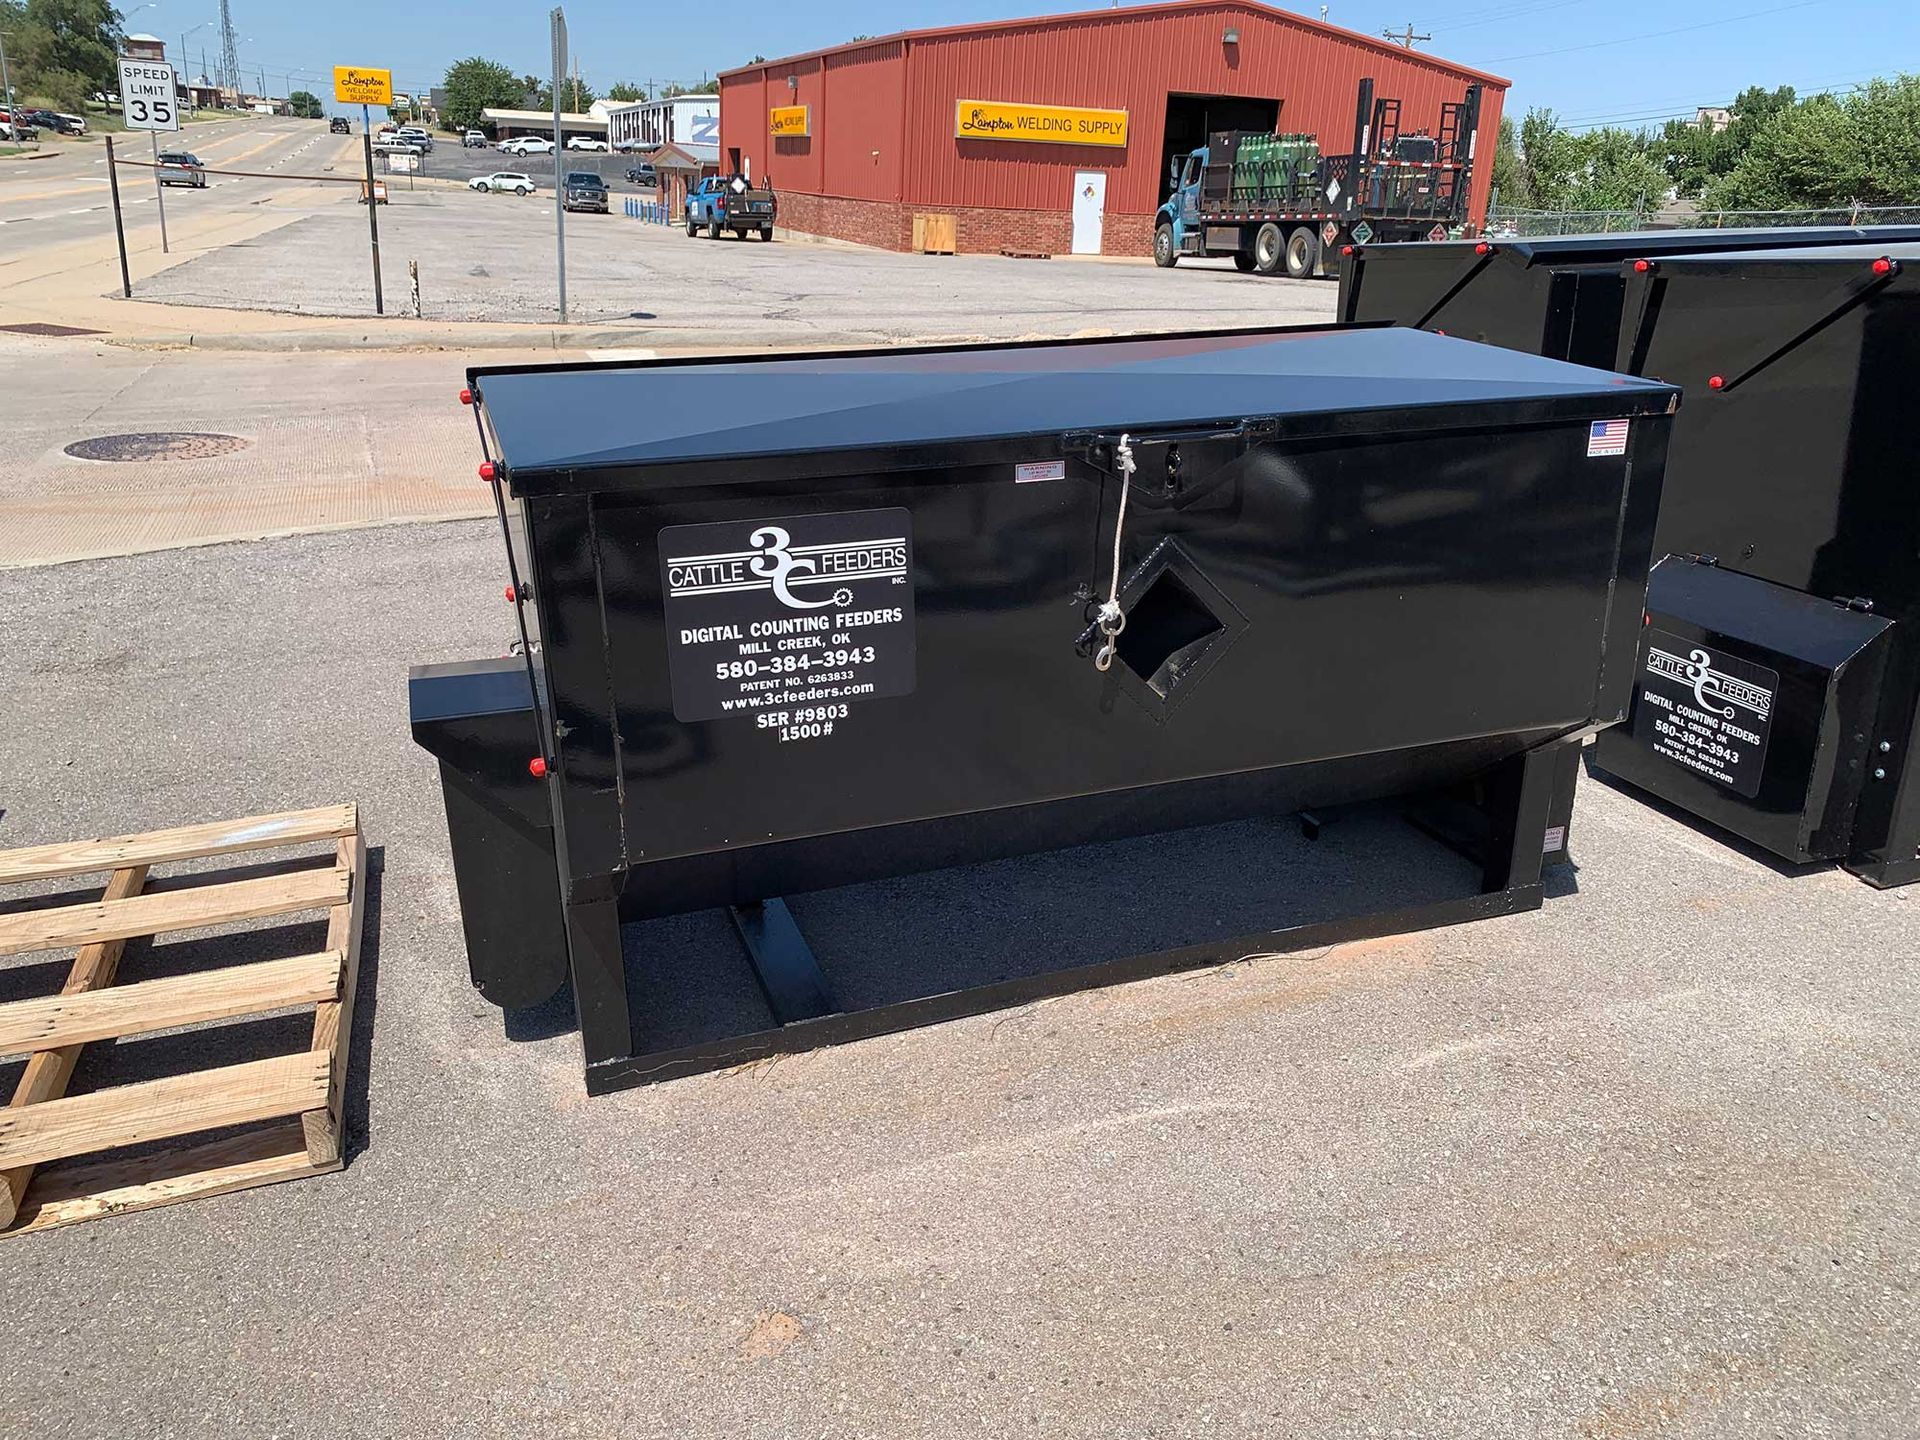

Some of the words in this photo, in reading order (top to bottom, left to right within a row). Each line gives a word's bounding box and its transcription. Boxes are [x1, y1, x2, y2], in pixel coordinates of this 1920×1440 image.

[124, 67, 169, 80] SPEED
[342, 70, 384, 87] Lampton
[130, 84, 165, 96] LIMIT
[345, 87, 382, 96] WELDING
[349, 94, 380, 102] SUPPLY
[130, 99, 171, 123] 35
[962, 109, 1014, 132] Lampton
[1017, 116, 1072, 132] WELDING
[1078, 119, 1123, 135] SUPPLY
[668, 562, 744, 587] CATTLE
[822, 547, 907, 573] FEEDERS
[891, 577, 907, 585] INC.
[680, 624, 743, 645] DIGITAL
[750, 615, 830, 638] COUNTING
[835, 607, 903, 629] FEEDERS
[739, 642, 772, 655] MILL
[777, 635, 826, 652] CREEK,
[831, 632, 851, 645] OK
[716, 646, 876, 680] 580-384-3943
[740, 679, 781, 692] PATENT
[785, 677, 804, 688] NO.
[807, 670, 854, 685] 6263833
[1647, 651, 1686, 677] CATTLE
[1721, 681, 1771, 710] FEEDERS
[721, 681, 874, 710] www.3cfeeders.com
[757, 711, 789, 729] SER
[794, 704, 849, 722] #9803
[1644, 690, 1674, 712] DIGITAL
[1676, 703, 1719, 730] COUNTING
[1721, 720, 1760, 746] FEEDERS
[1668, 714, 1686, 726] MILL
[1688, 721, 1714, 739] CREEK,
[1716, 733, 1728, 744] OK
[1655, 720, 1739, 764] 580-384-3943
[1664, 738, 1685, 751] PATENT
[1654, 744, 1734, 785] www.3cfeeders.com
